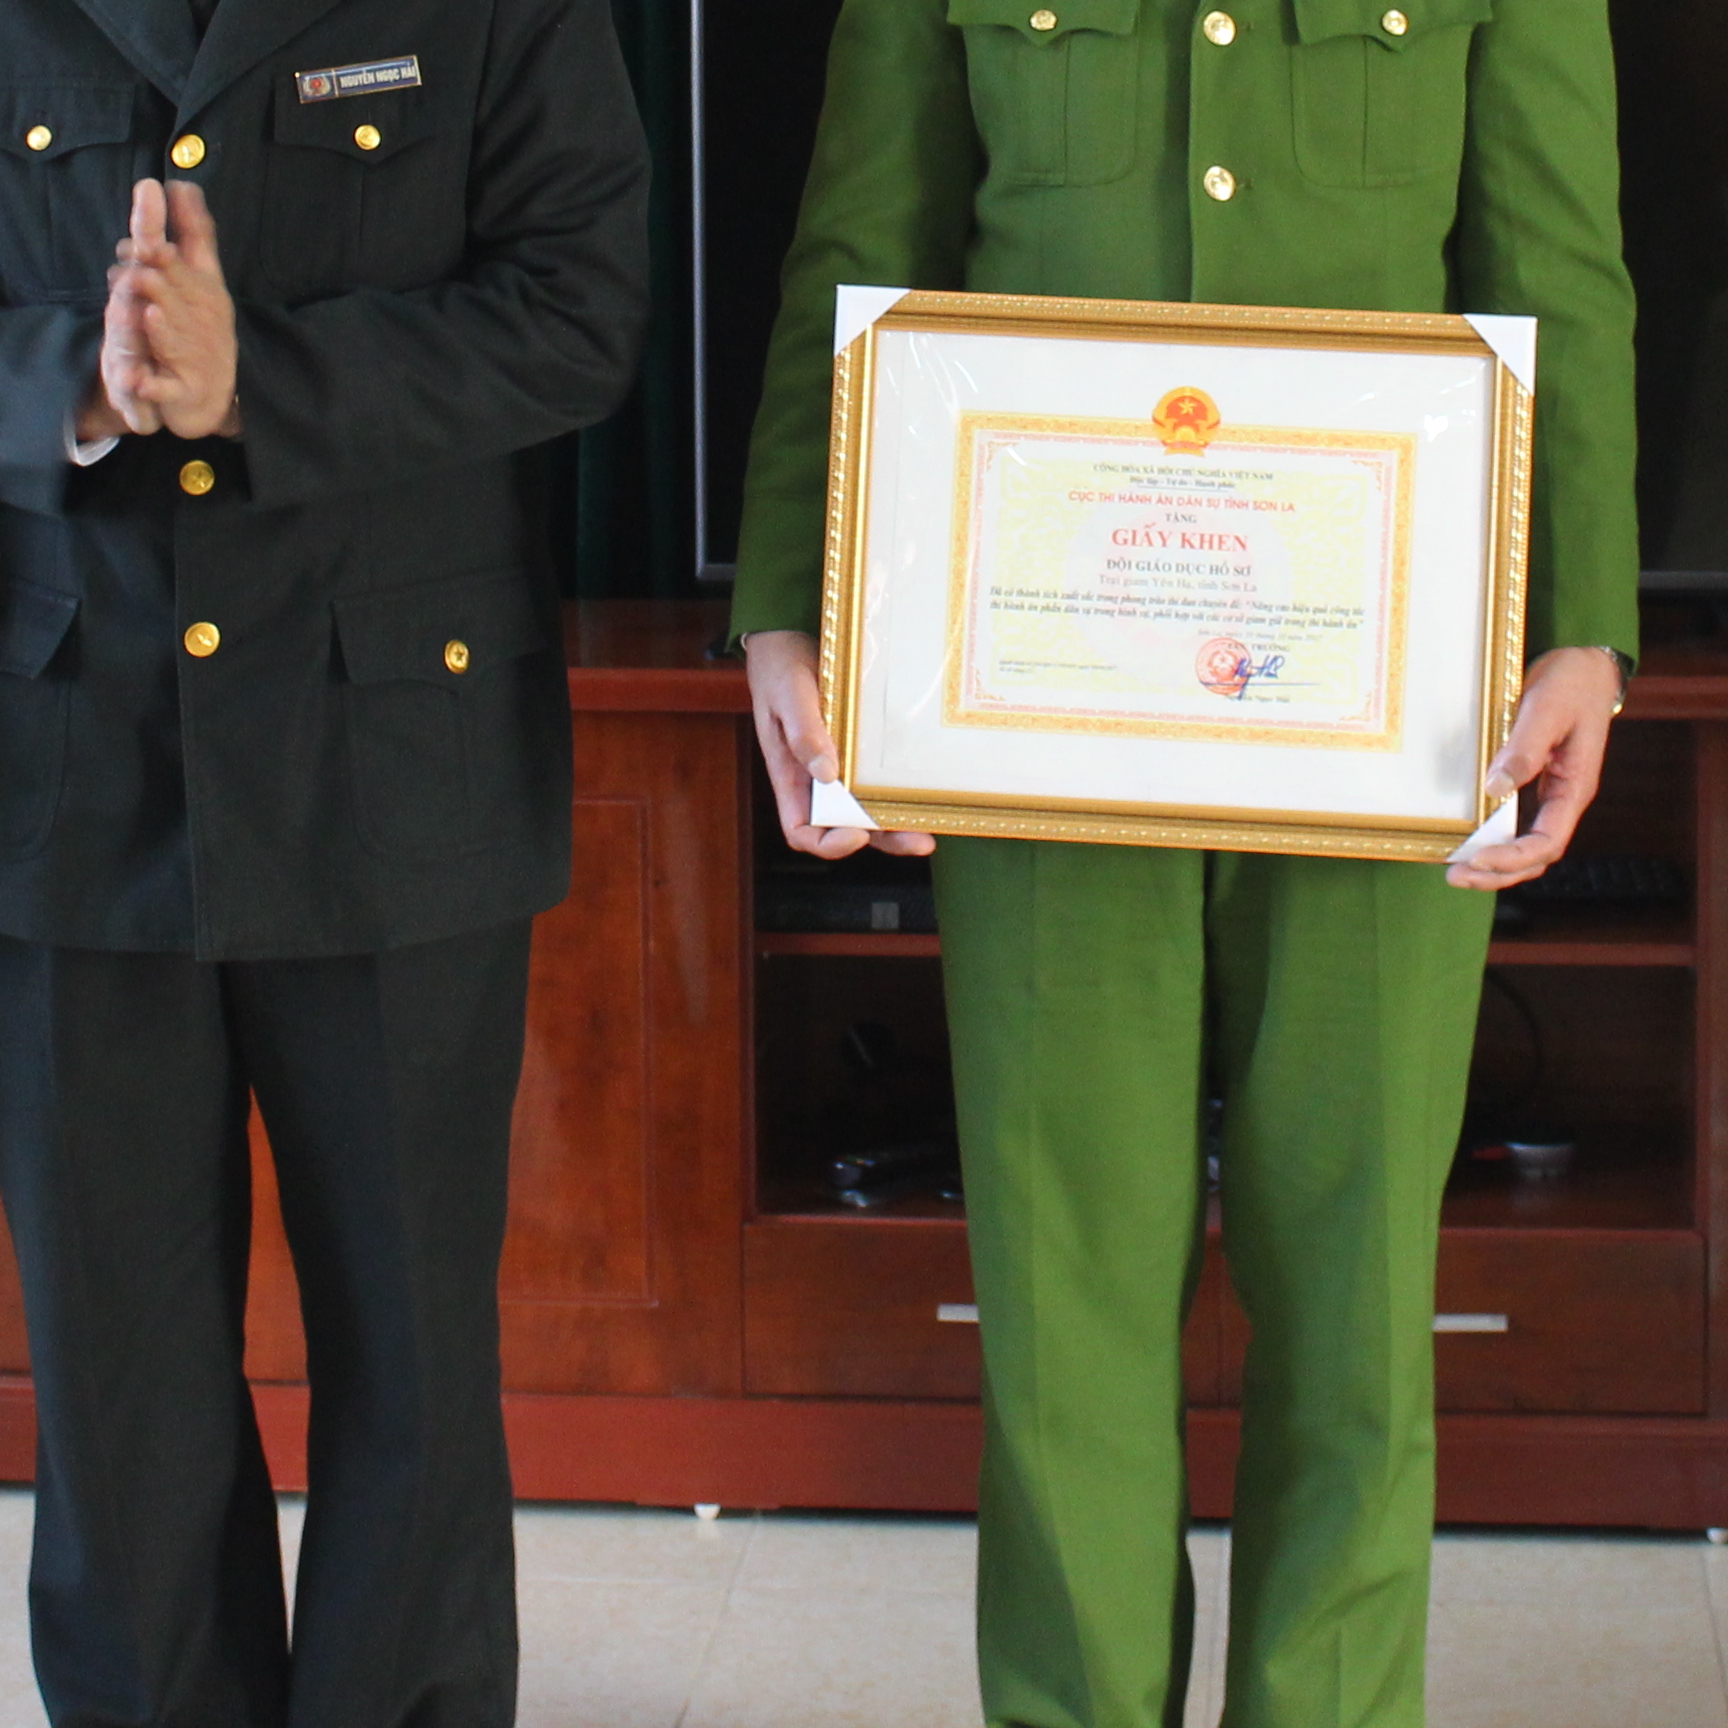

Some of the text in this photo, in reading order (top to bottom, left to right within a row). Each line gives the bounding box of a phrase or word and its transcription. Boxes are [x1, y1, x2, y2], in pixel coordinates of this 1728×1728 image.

[340, 71, 374, 88] NGUYỄN
[376, 69, 399, 84] NGỌC
[1068, 489, 1295, 513] CỤC THI HÀNH ÁN DÂN SỰ TỈNH SƠN LA
[1165, 512, 1198, 524] TẶNG
[1112, 522, 1248, 552] GIẤY KHEN
[1106, 556, 1252, 576] ĐỘI GIÁO DỤC HỒ SƠ
